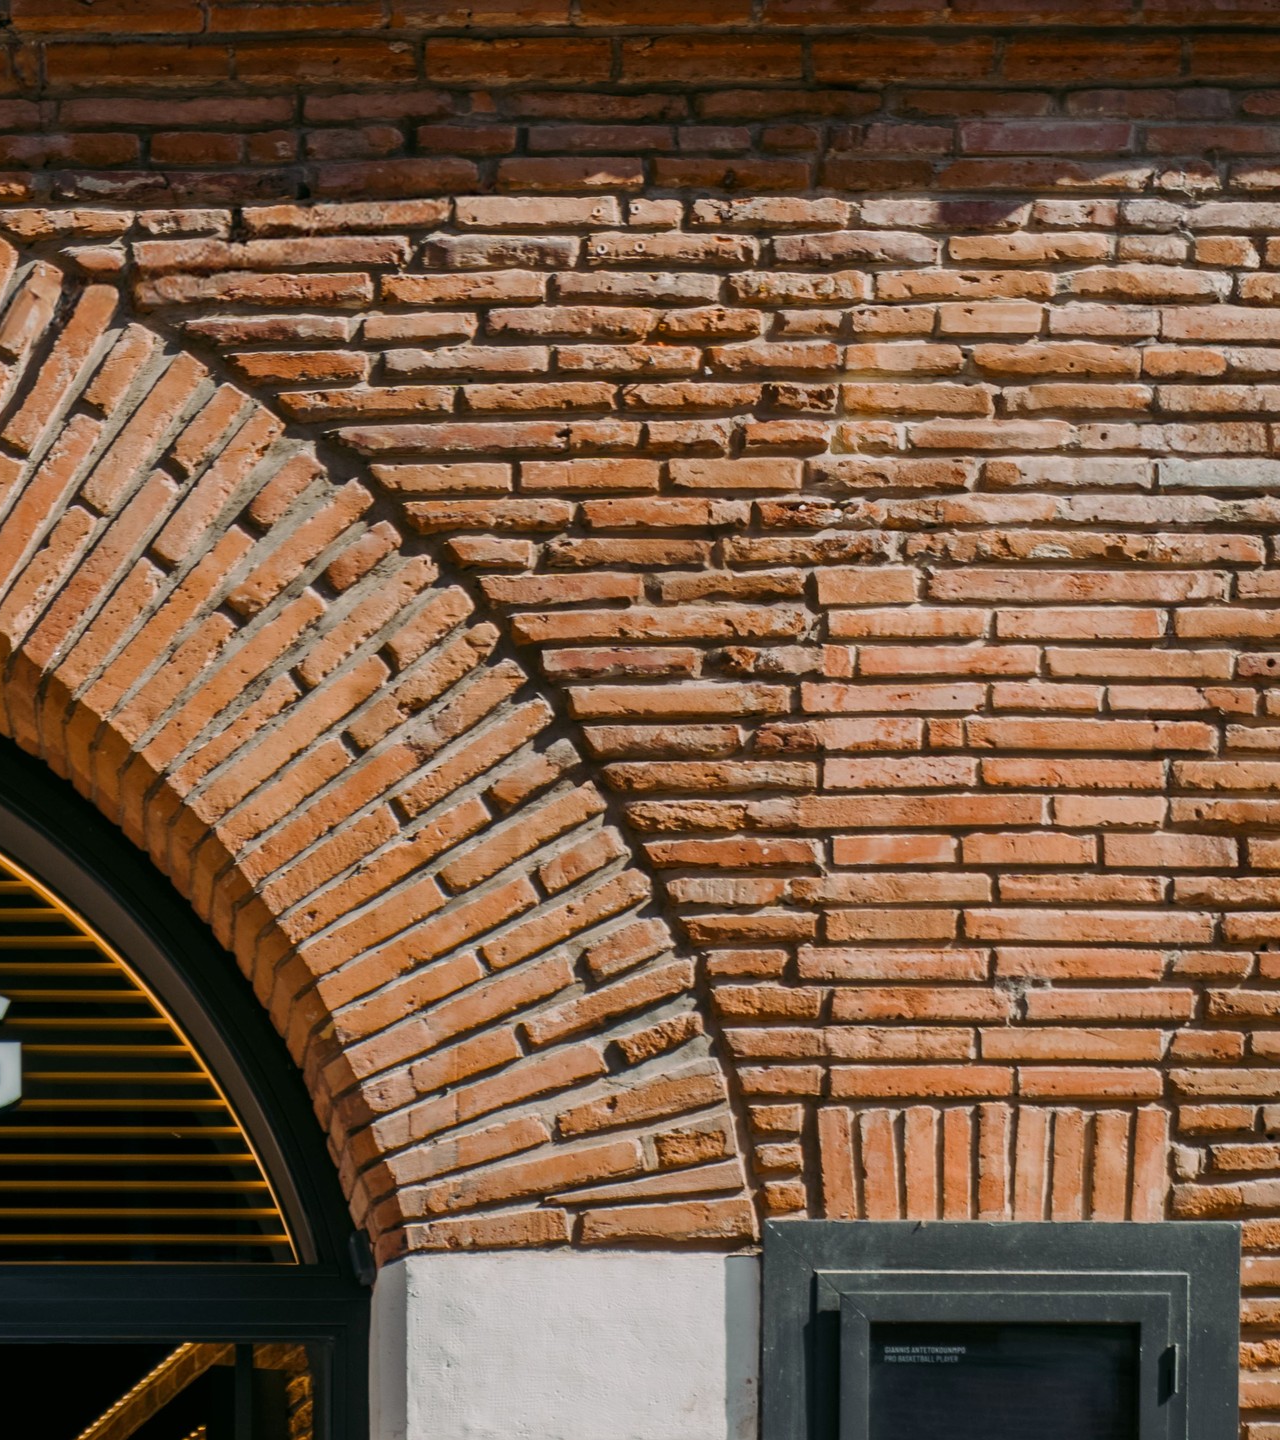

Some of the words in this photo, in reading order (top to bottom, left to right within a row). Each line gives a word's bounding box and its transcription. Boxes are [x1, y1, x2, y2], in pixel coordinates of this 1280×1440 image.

[884, 1346, 910, 1354] GIANNIS
[884, 1355, 896, 1363] PRO
[897, 1355, 935, 1363] BASKETBALL
[936, 1355, 959, 1363] PLAYER
